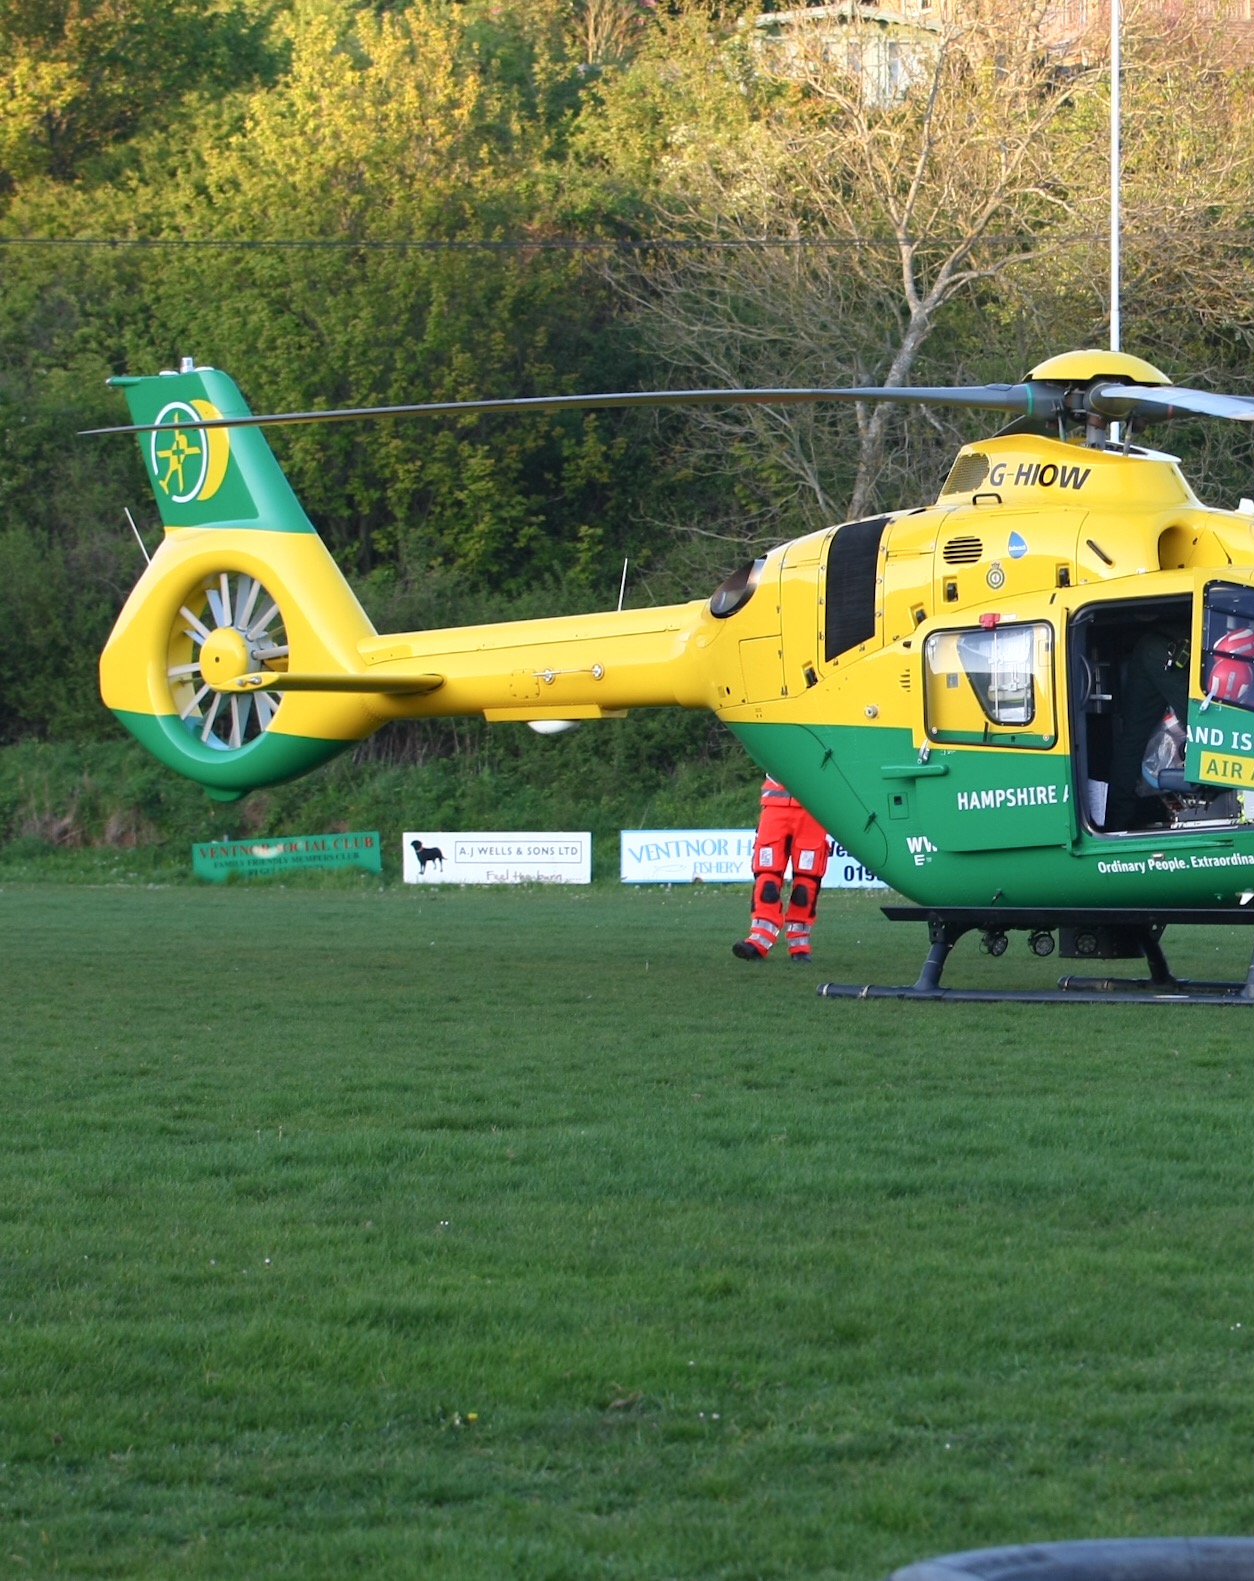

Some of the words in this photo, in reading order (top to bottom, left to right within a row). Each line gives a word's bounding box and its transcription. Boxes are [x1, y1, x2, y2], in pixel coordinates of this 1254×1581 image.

[989, 463, 1092, 490] G-HIOW
[1206, 758, 1243, 779] AIR
[957, 785, 1058, 810] HAMPSHIRE
[200, 844, 270, 859] VENTNOR
[275, 839, 326, 853] SOCIAL
[332, 836, 374, 849] CLUB
[477, 846, 512, 856] WELLS
[516, 846, 523, 856] &
[527, 846, 555, 856] SONS
[558, 846, 578, 856] LTD
[628, 838, 729, 863] VENTNOR
[214, 858, 246, 868] FAMILY
[247, 855, 289, 866] FRIENDLY
[336, 851, 360, 860] CLUB
[693, 861, 744, 873] FISHERY
[1097, 860, 1146, 874] Ordinary
[1147, 856, 1190, 872] People.
[486, 869, 510, 881] Feel
[844, 865, 880, 882] 019
